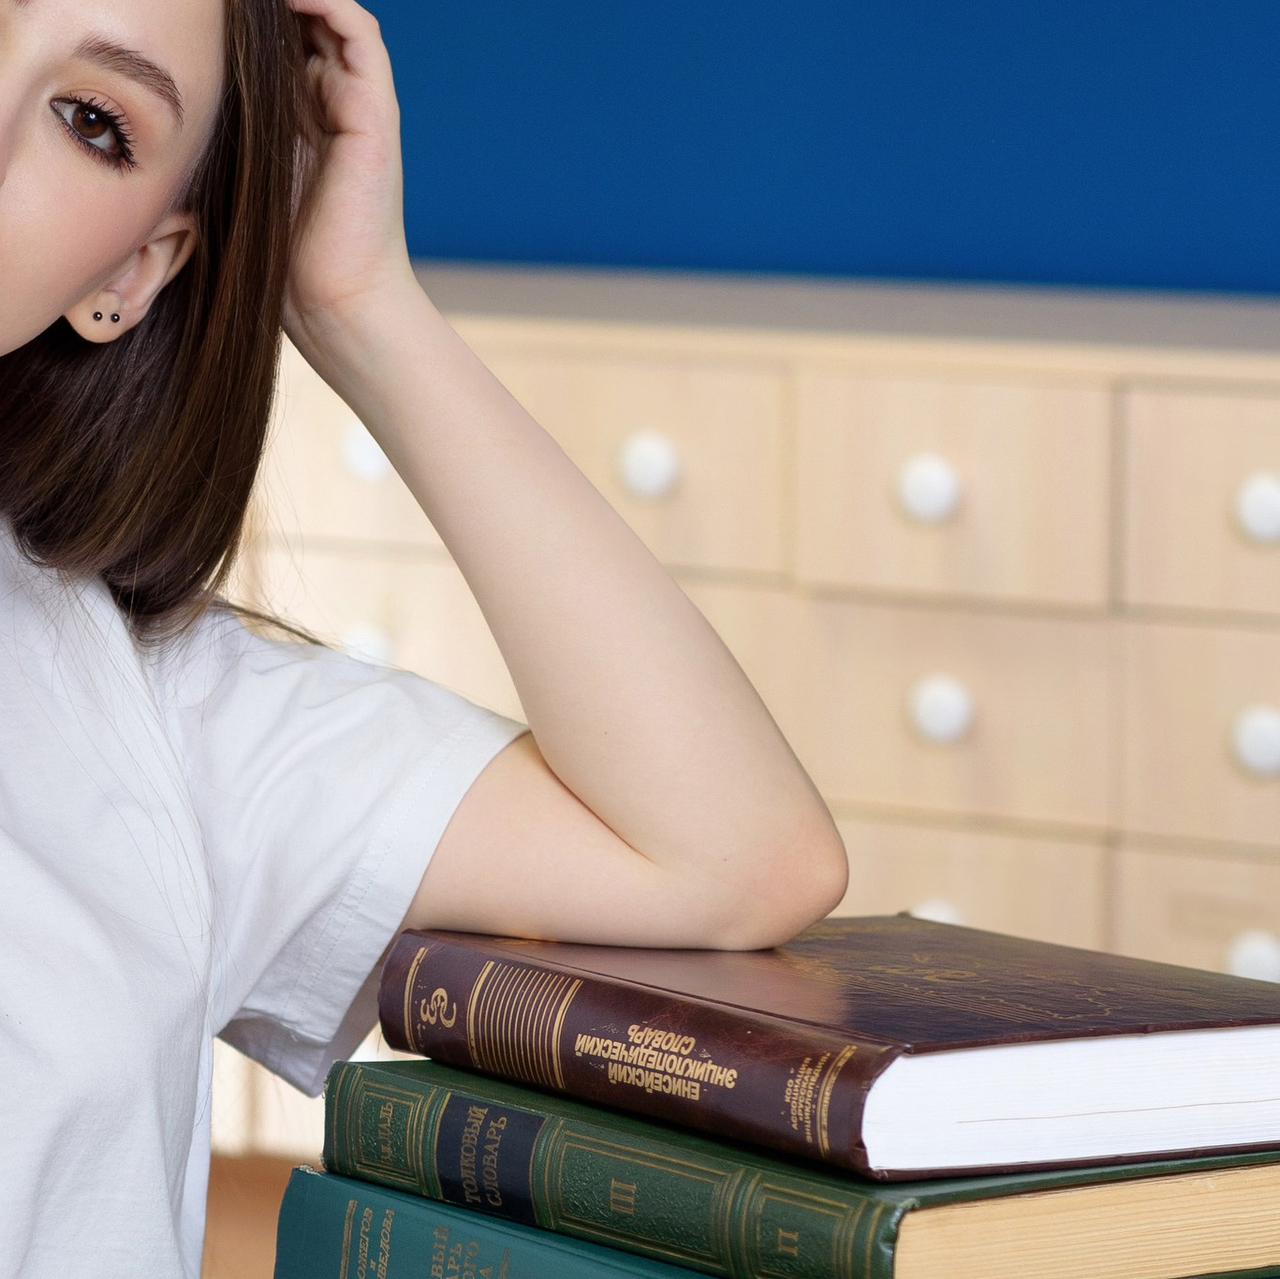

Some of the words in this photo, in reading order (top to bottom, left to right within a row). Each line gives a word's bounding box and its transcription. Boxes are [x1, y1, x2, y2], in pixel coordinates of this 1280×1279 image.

[575, 1033, 738, 1089] ЭНЦИКЛОПЕДИЧЕСКИЙ
[626, 1023, 696, 1055] СЛОВАРЬ
[608, 1062, 701, 1101] ЕНИСЕЙСКИЙ
[460, 1105, 489, 1204] ТОЛКОВЫЙ
[483, 1116, 508, 1207] СЛОВАРЬ
